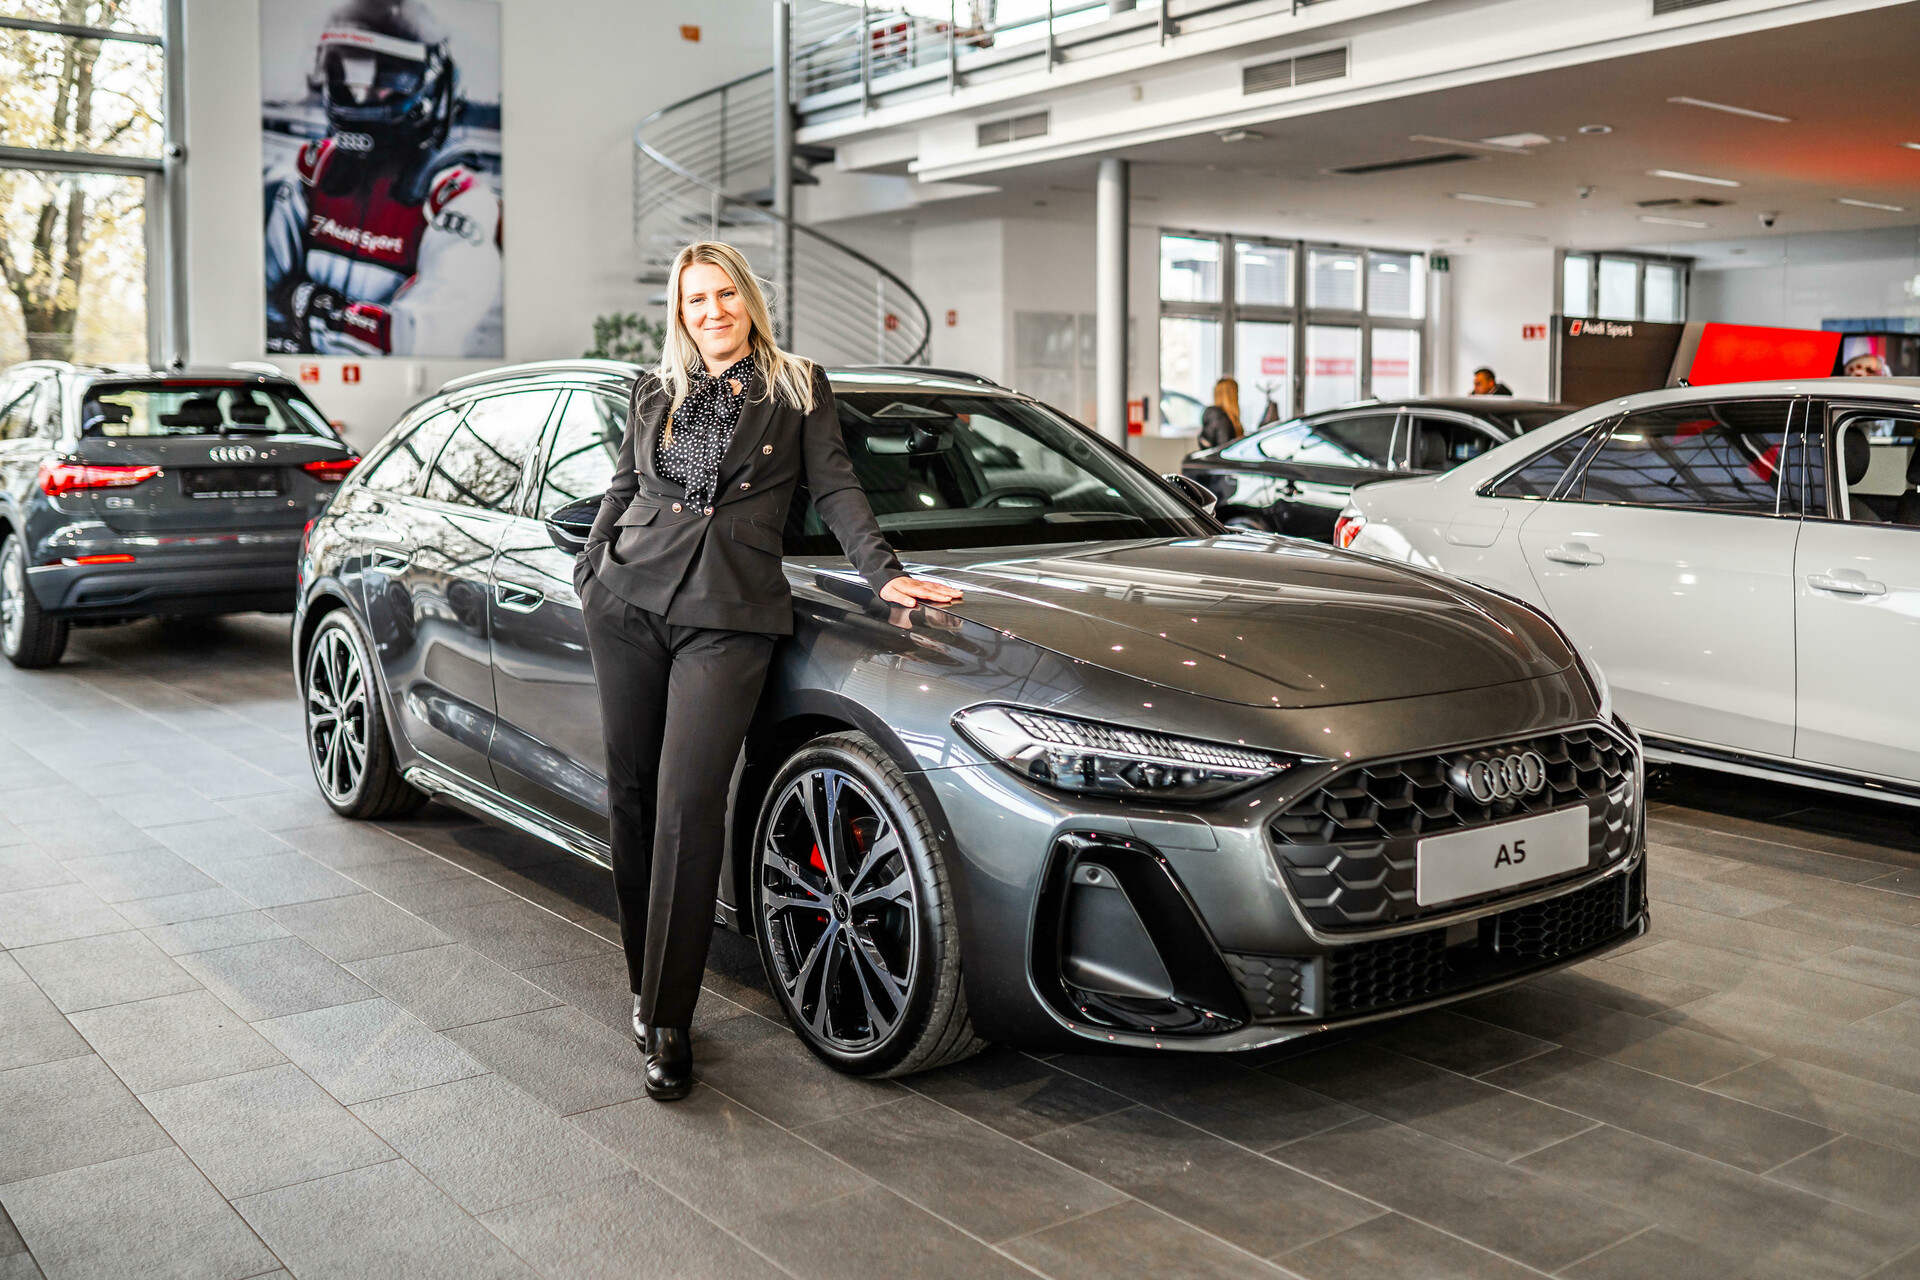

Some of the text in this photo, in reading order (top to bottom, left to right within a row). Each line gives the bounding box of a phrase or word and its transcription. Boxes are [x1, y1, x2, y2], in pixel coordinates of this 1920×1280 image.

[322, 219, 403, 254] Audi Sport
[1582, 320, 1633, 338] Audi Sport
[1494, 840, 1526, 869] A5
